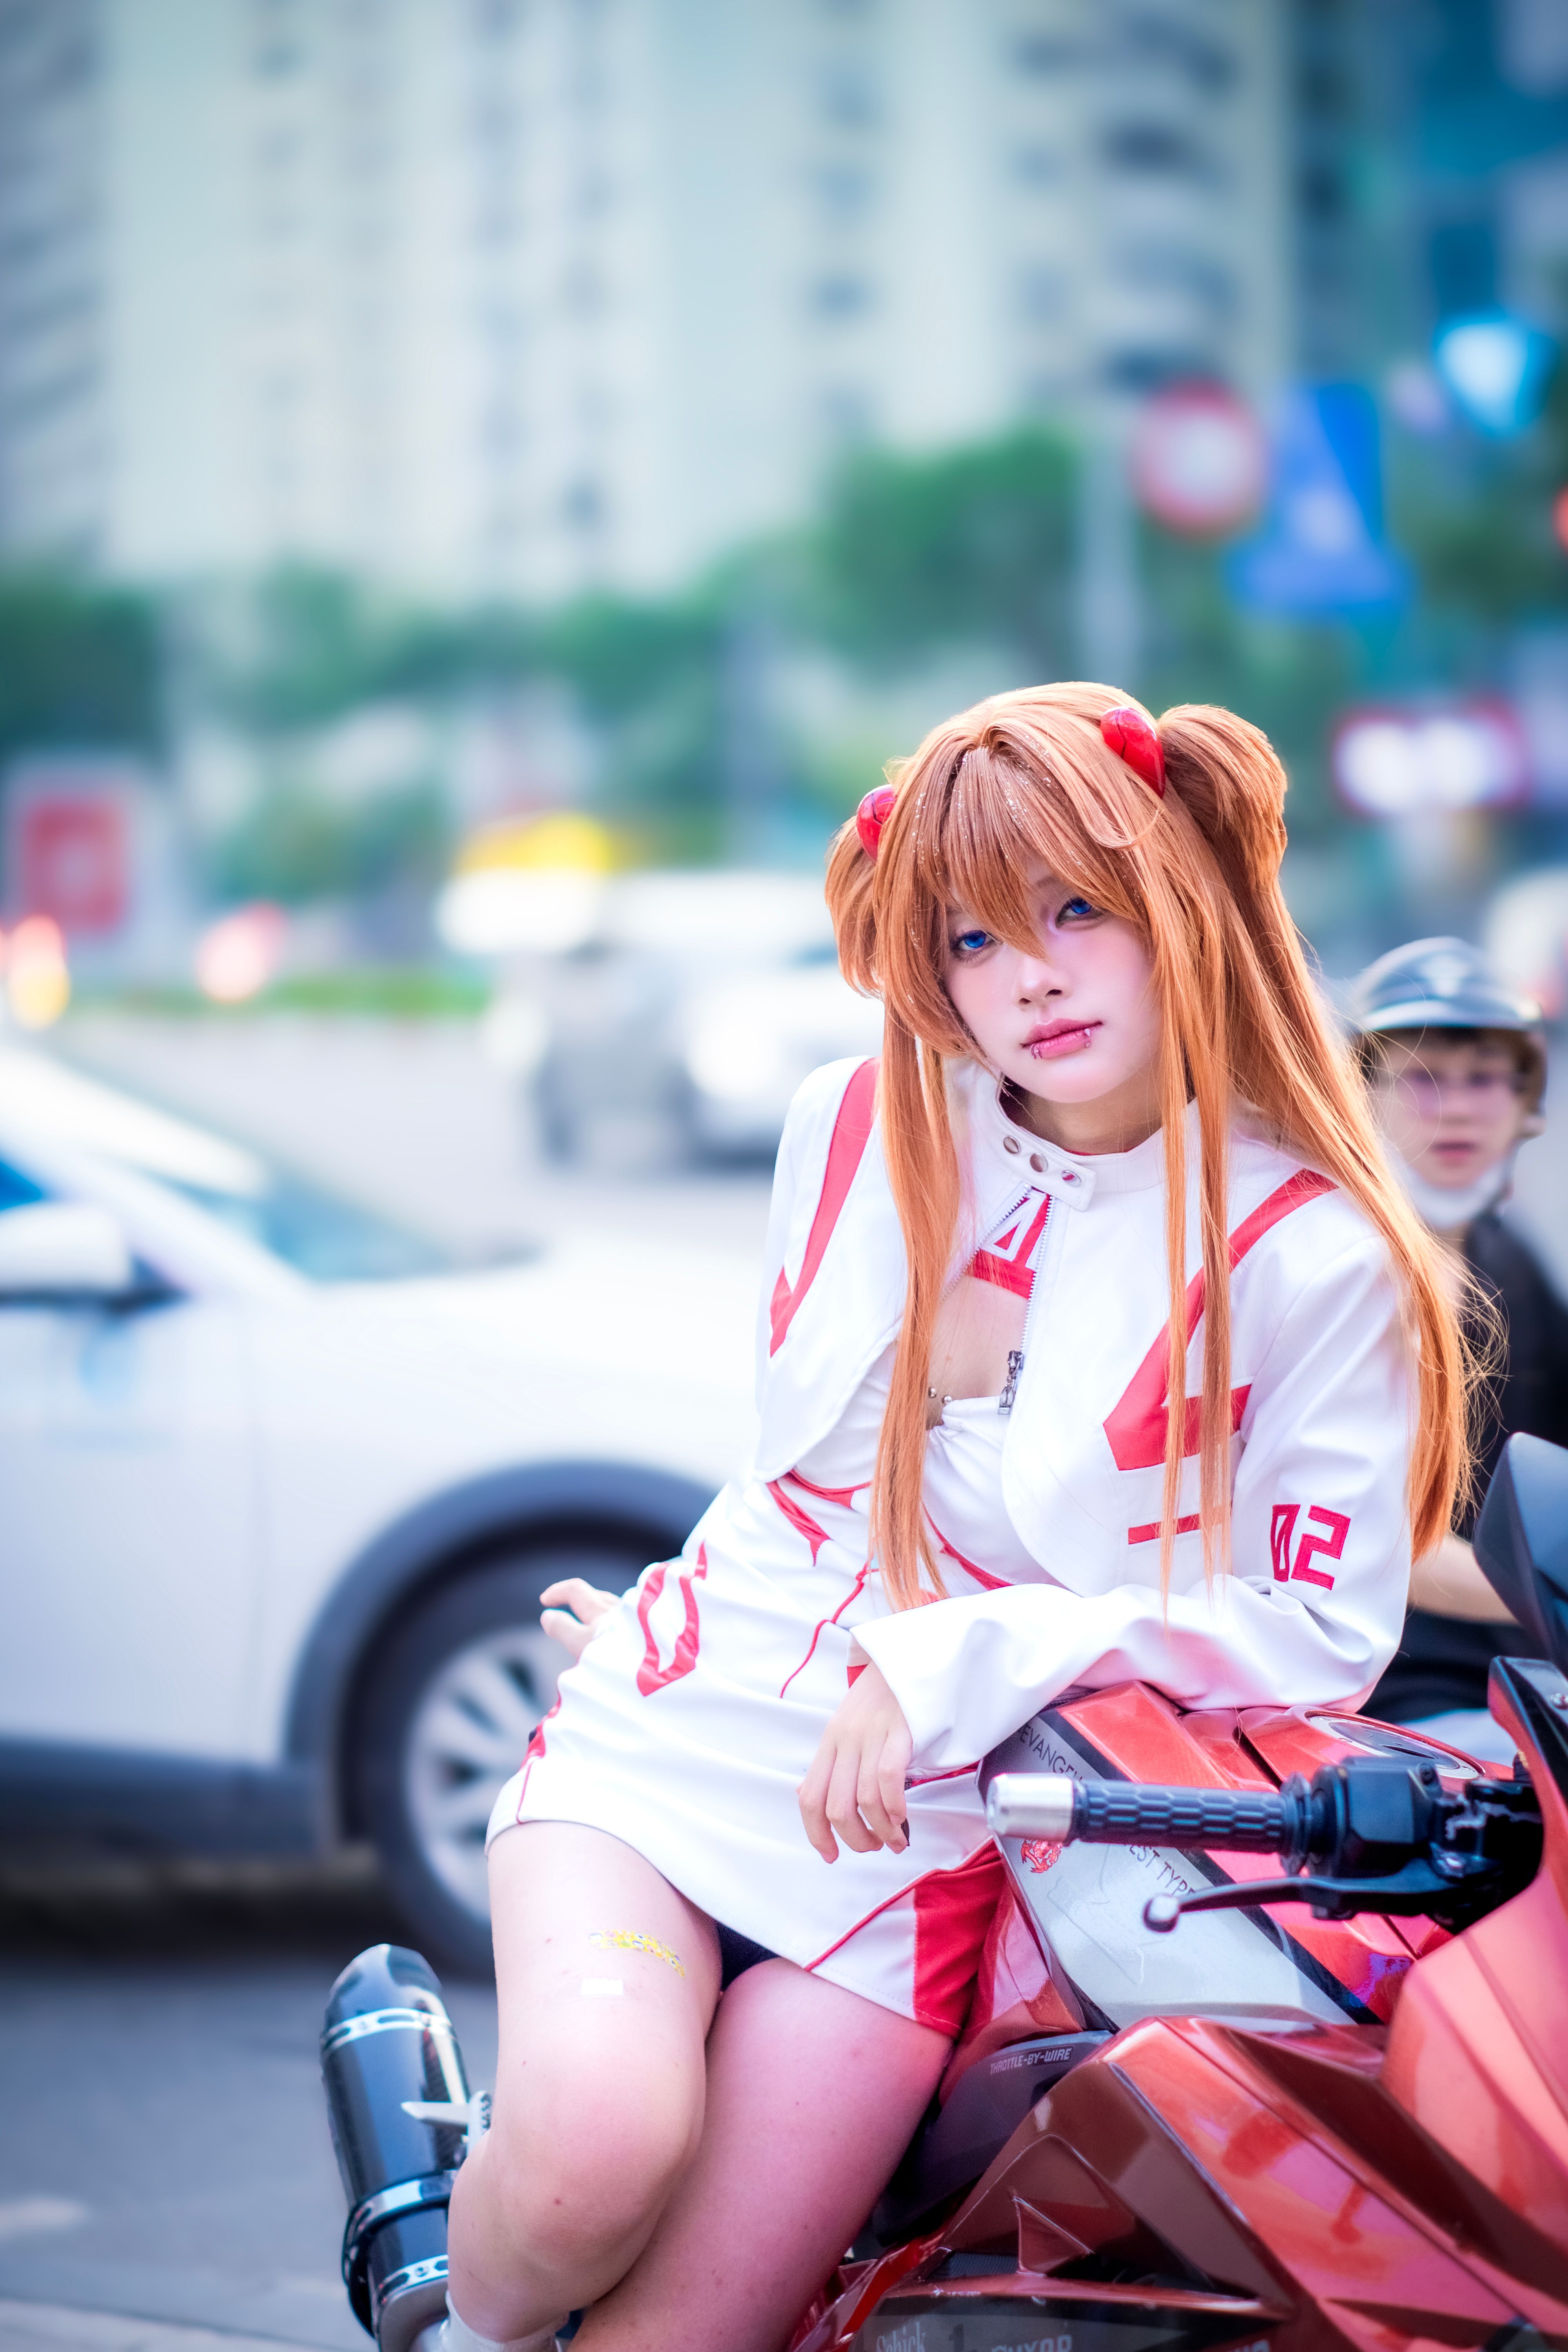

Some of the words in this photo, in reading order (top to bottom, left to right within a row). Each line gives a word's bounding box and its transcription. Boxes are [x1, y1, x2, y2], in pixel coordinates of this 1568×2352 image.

[1270, 1504, 1351, 1591] 02
[1020, 1724, 1083, 1782] EVANG
[990, 2047, 1072, 2075] THROTTLE-BY-WIRE
